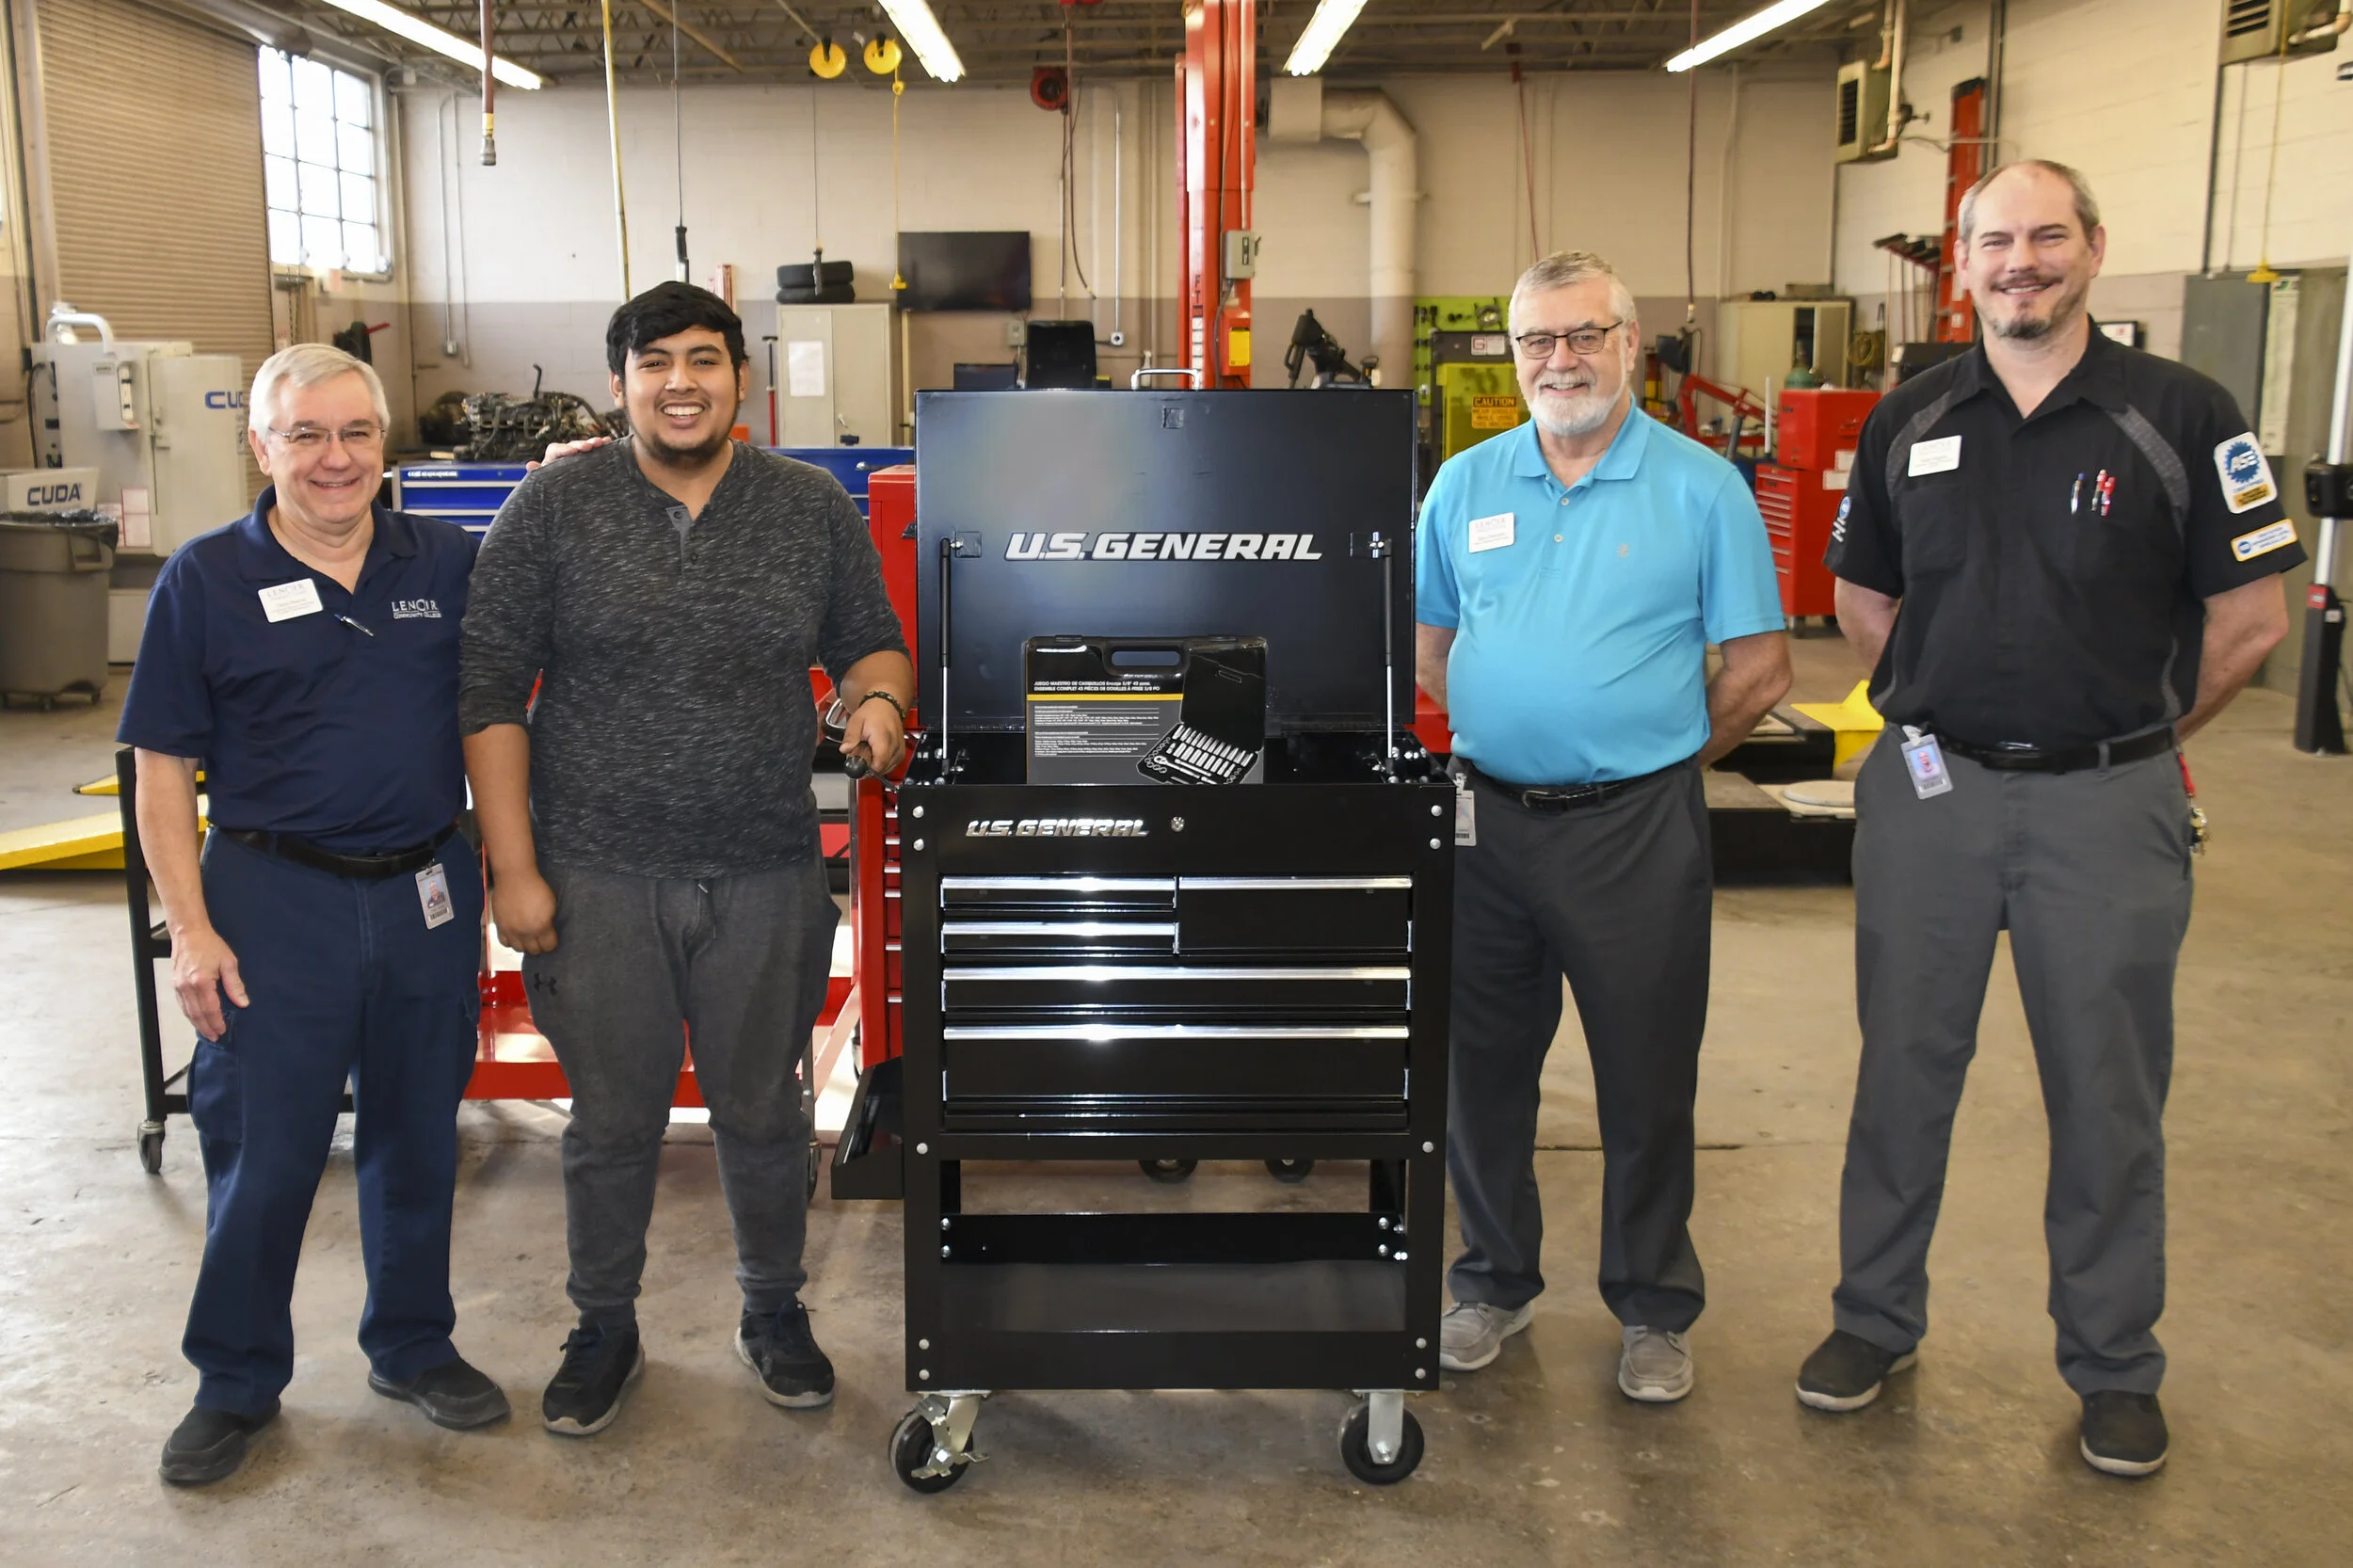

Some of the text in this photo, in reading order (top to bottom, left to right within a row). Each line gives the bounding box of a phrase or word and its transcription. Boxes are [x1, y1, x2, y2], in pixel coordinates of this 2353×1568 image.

[1474, 396, 1514, 407] CAUTION
[2230, 450, 2258, 473] ASE
[27, 482, 81, 506] CUDA
[1092, 532, 1323, 561] GENERAL
[392, 599, 439, 612] LENOIR
[966, 818, 1150, 837] U.S. GENERAL
